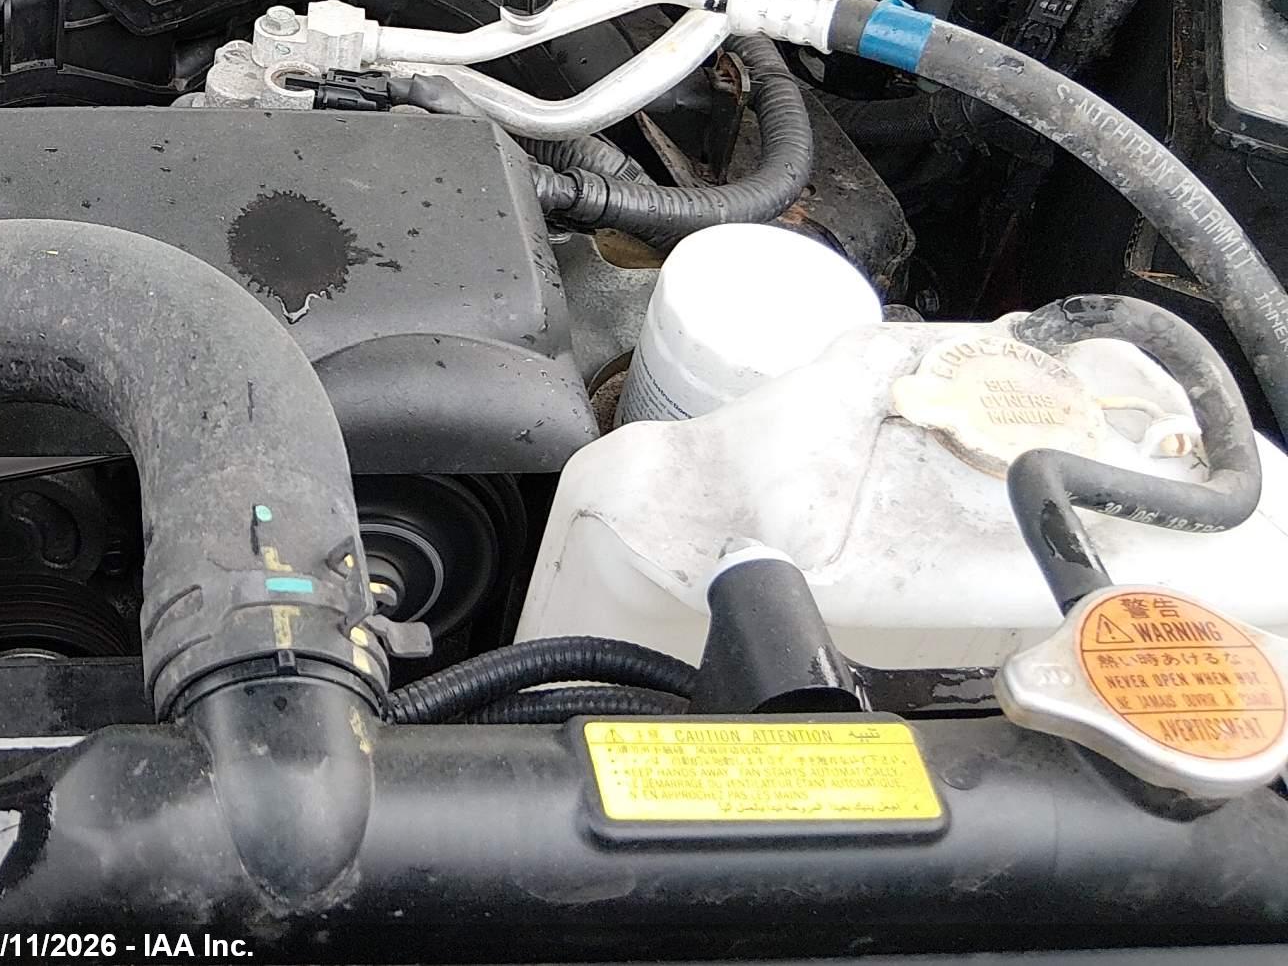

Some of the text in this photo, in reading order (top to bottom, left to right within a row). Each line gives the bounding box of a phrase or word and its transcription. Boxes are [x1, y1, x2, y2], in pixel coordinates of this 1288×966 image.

[931, 336, 1070, 380] COOLANT
[983, 379, 1023, 393] SEE
[987, 410, 1065, 425] MANUAL
[1119, 597, 1180, 619] 警告
[1131, 621, 1223, 643] WARNING
[1104, 675, 1150, 689] NEVER
[1152, 672, 1189, 687] OPEN
[1192, 671, 1232, 685] WHEN
[1116, 696, 1131, 710] NE
[1137, 694, 1177, 709] JAMAIS
[674, 729, 741, 743] CAUTION
[752, 729, 833, 743] ATTENTION
[657, 767, 697, 778] HANDS
[763, 767, 806, 778] STARTS
